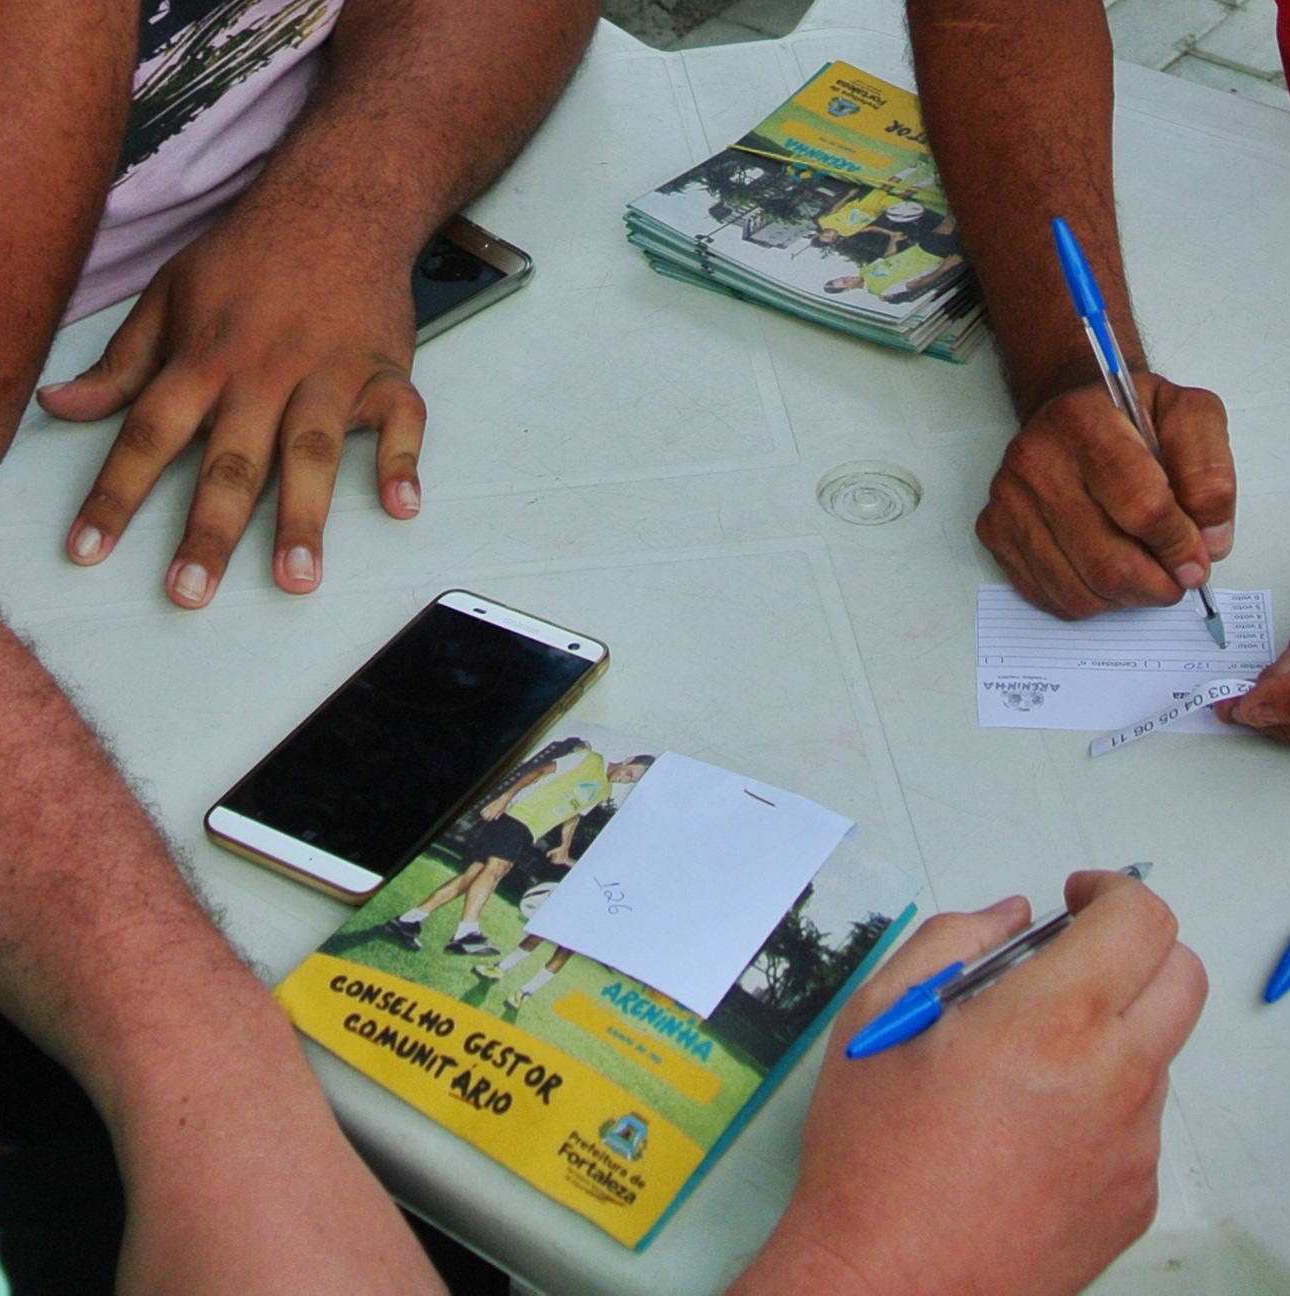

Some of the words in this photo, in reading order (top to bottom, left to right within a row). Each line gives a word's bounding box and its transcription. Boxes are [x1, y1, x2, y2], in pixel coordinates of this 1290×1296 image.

[983, 681, 1060, 692] ARENINHA
[1208, 684, 1231, 699] 03
[1184, 694, 1204, 711] 04
[1159, 708, 1179, 725] 05
[1133, 721, 1154, 737] 06
[1111, 733, 1127, 747] 11
[602, 980, 714, 1064] ARENINHA
[329, 974, 455, 1039] CONSELHO
[463, 1032, 563, 1107] GESTOR
[568, 1130, 627, 1176] Prefeitura
[629, 1174, 645, 1189] de
[557, 1141, 636, 1205] Fortaleza
